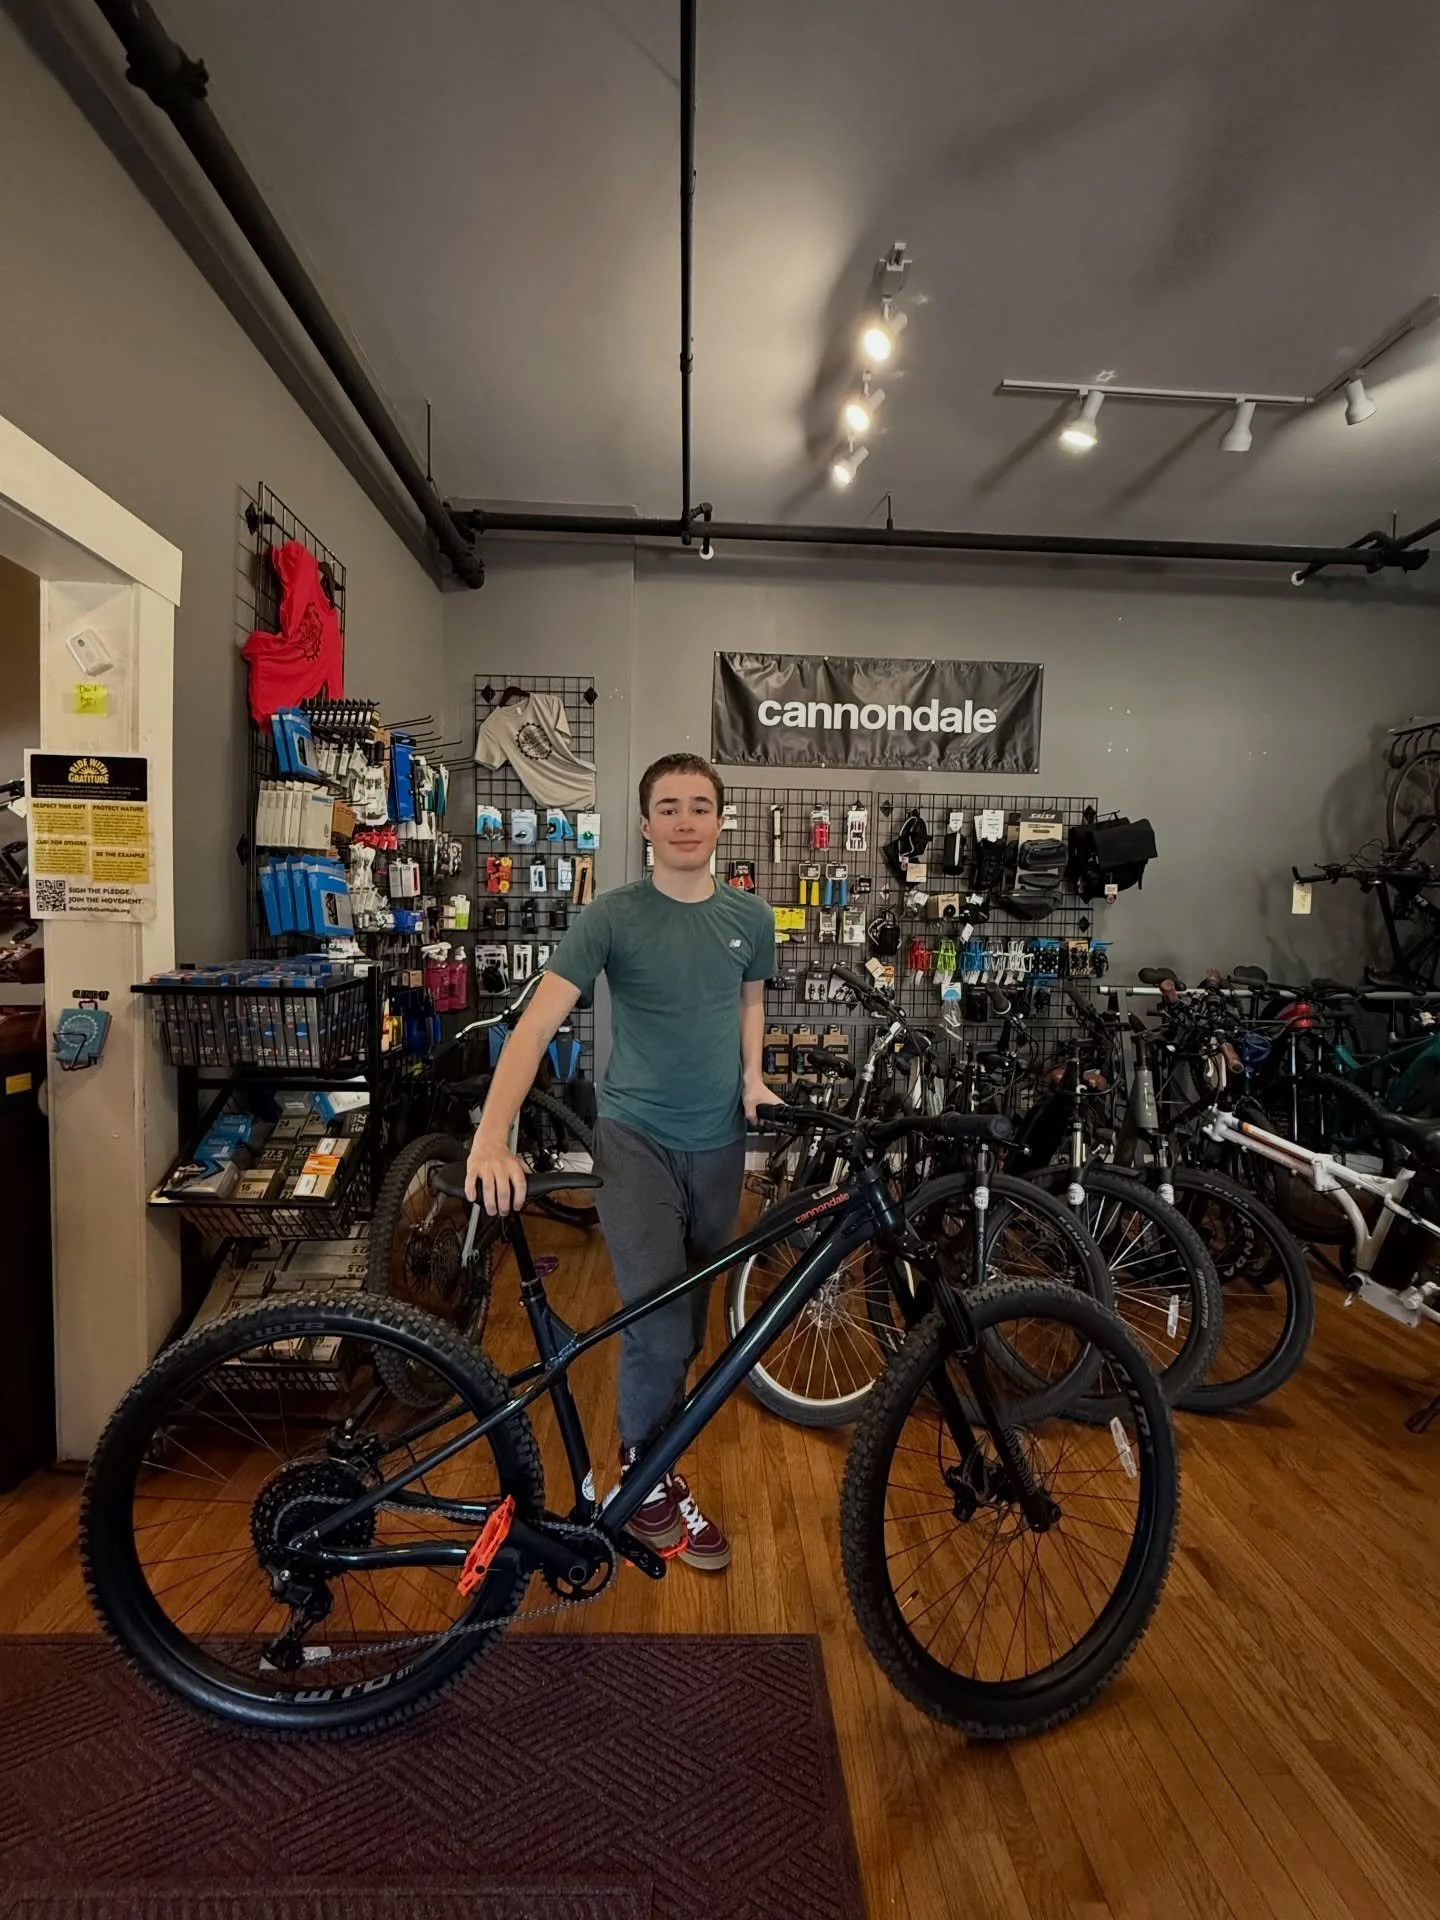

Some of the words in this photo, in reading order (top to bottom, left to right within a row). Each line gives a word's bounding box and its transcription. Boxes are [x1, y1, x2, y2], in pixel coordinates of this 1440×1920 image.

[757, 698, 997, 734] cannondale
[69, 758, 88, 774] RIDE
[89, 758, 109, 775] WITH
[68, 772, 110, 784] GRATITUDE
[68, 896, 84, 904] JOIN
[794, 1192, 850, 1224] cannondale
